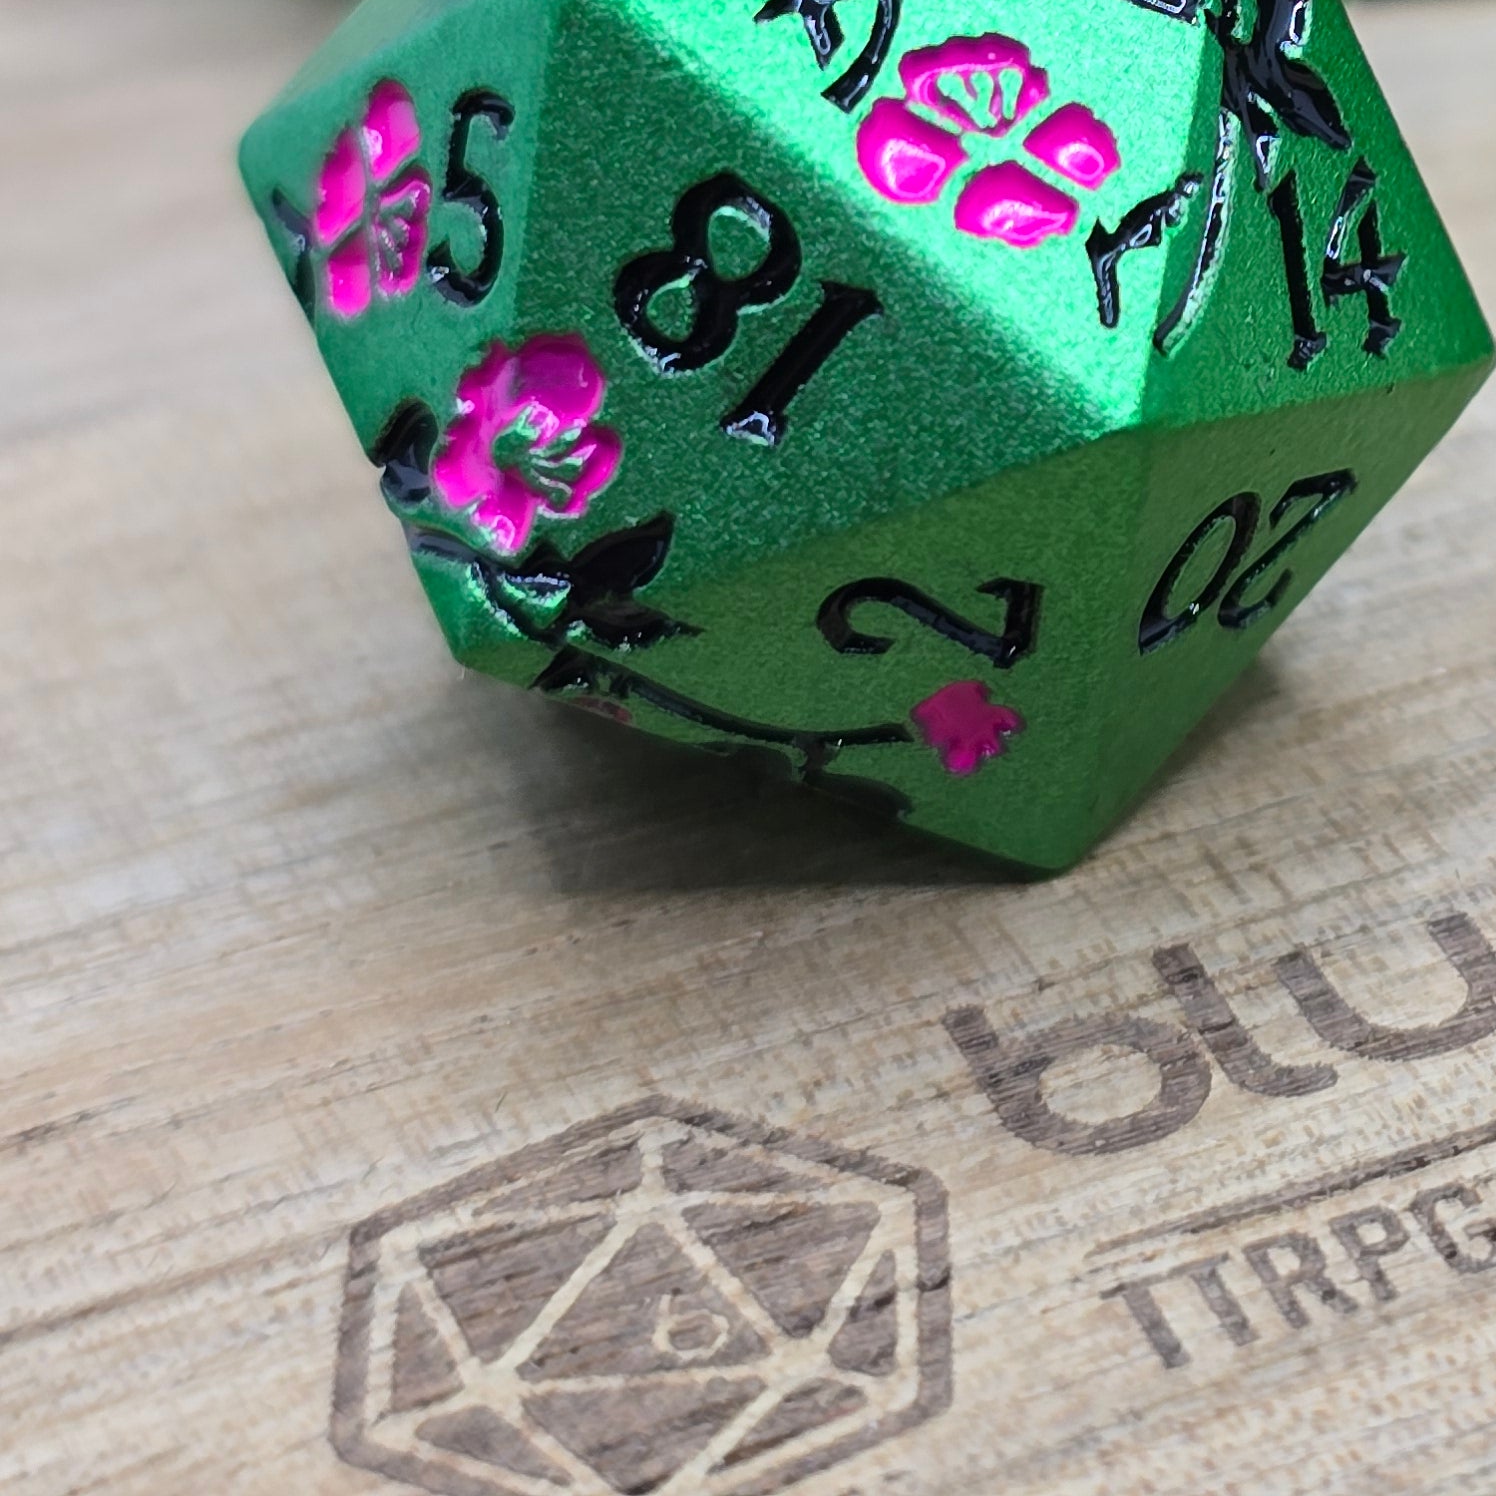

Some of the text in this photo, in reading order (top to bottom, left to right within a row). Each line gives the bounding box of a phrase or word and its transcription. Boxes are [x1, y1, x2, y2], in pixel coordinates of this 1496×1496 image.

[425, 84, 516, 307] 5
[1266, 154, 1409, 372] 14
[815, 573, 1046, 670] 2
[1136, 467, 1357, 656] 20
